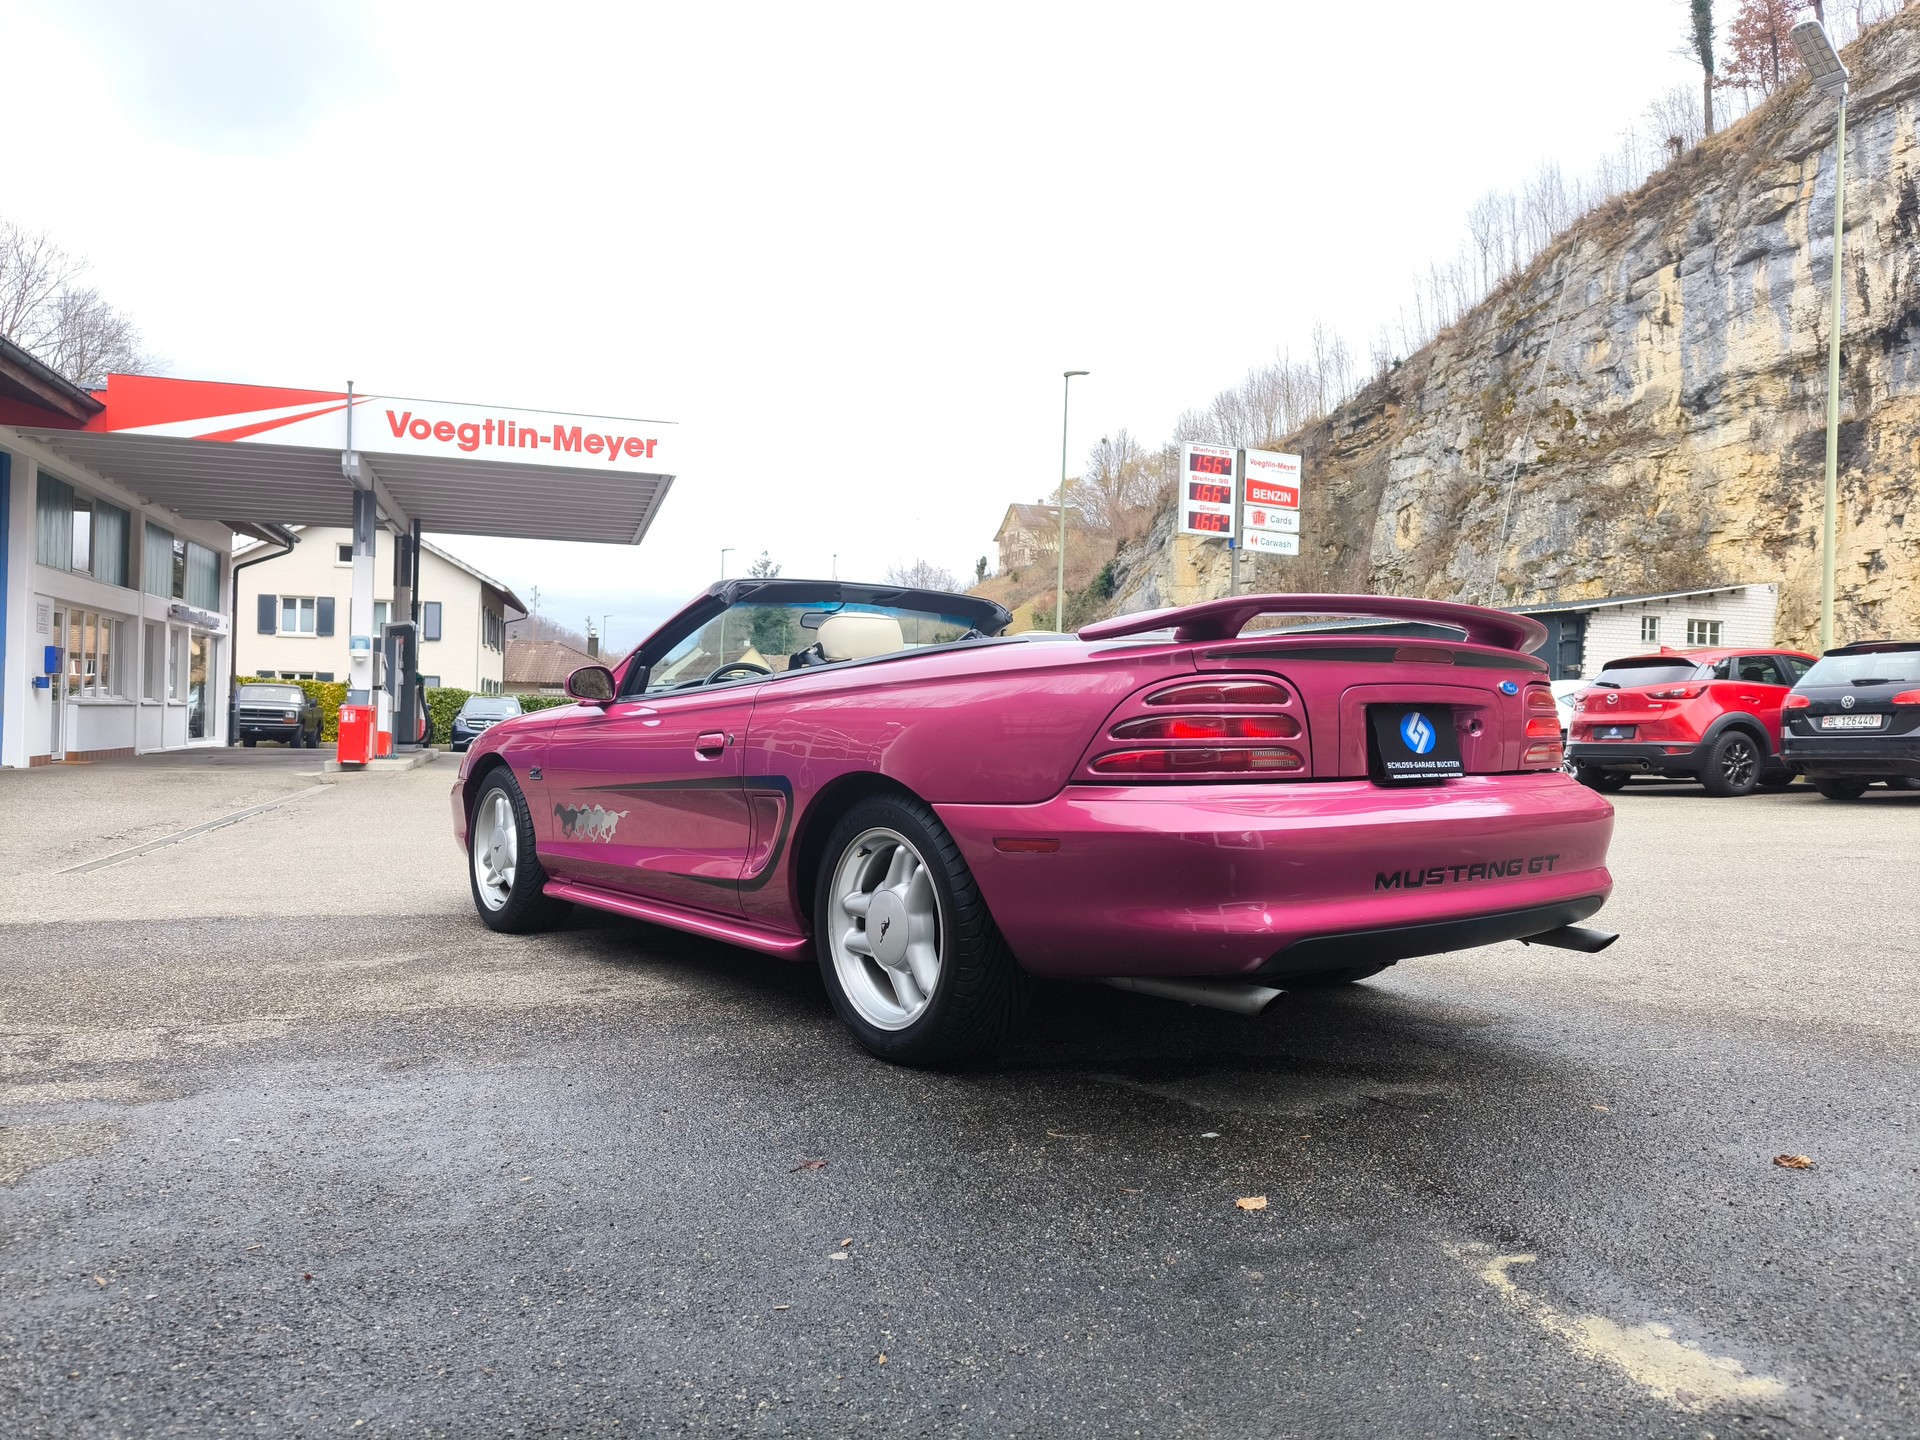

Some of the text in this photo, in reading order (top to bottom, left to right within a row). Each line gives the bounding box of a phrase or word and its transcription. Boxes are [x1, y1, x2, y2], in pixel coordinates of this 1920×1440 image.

[385, 410, 658, 462] Voegtlin-Meyer
[1193, 446, 1217, 454] Bleifrei
[1249, 458, 1297, 471] Voegtlin-Meyer
[1253, 488, 1291, 502] BENZIN
[1199, 504, 1221, 512] Diesel
[1270, 515, 1293, 526] Cards
[1260, 537, 1292, 549] Carwash
[1436, 760, 1460, 768] BUCKTEN
[1374, 854, 1559, 890] MUSTANG GT
